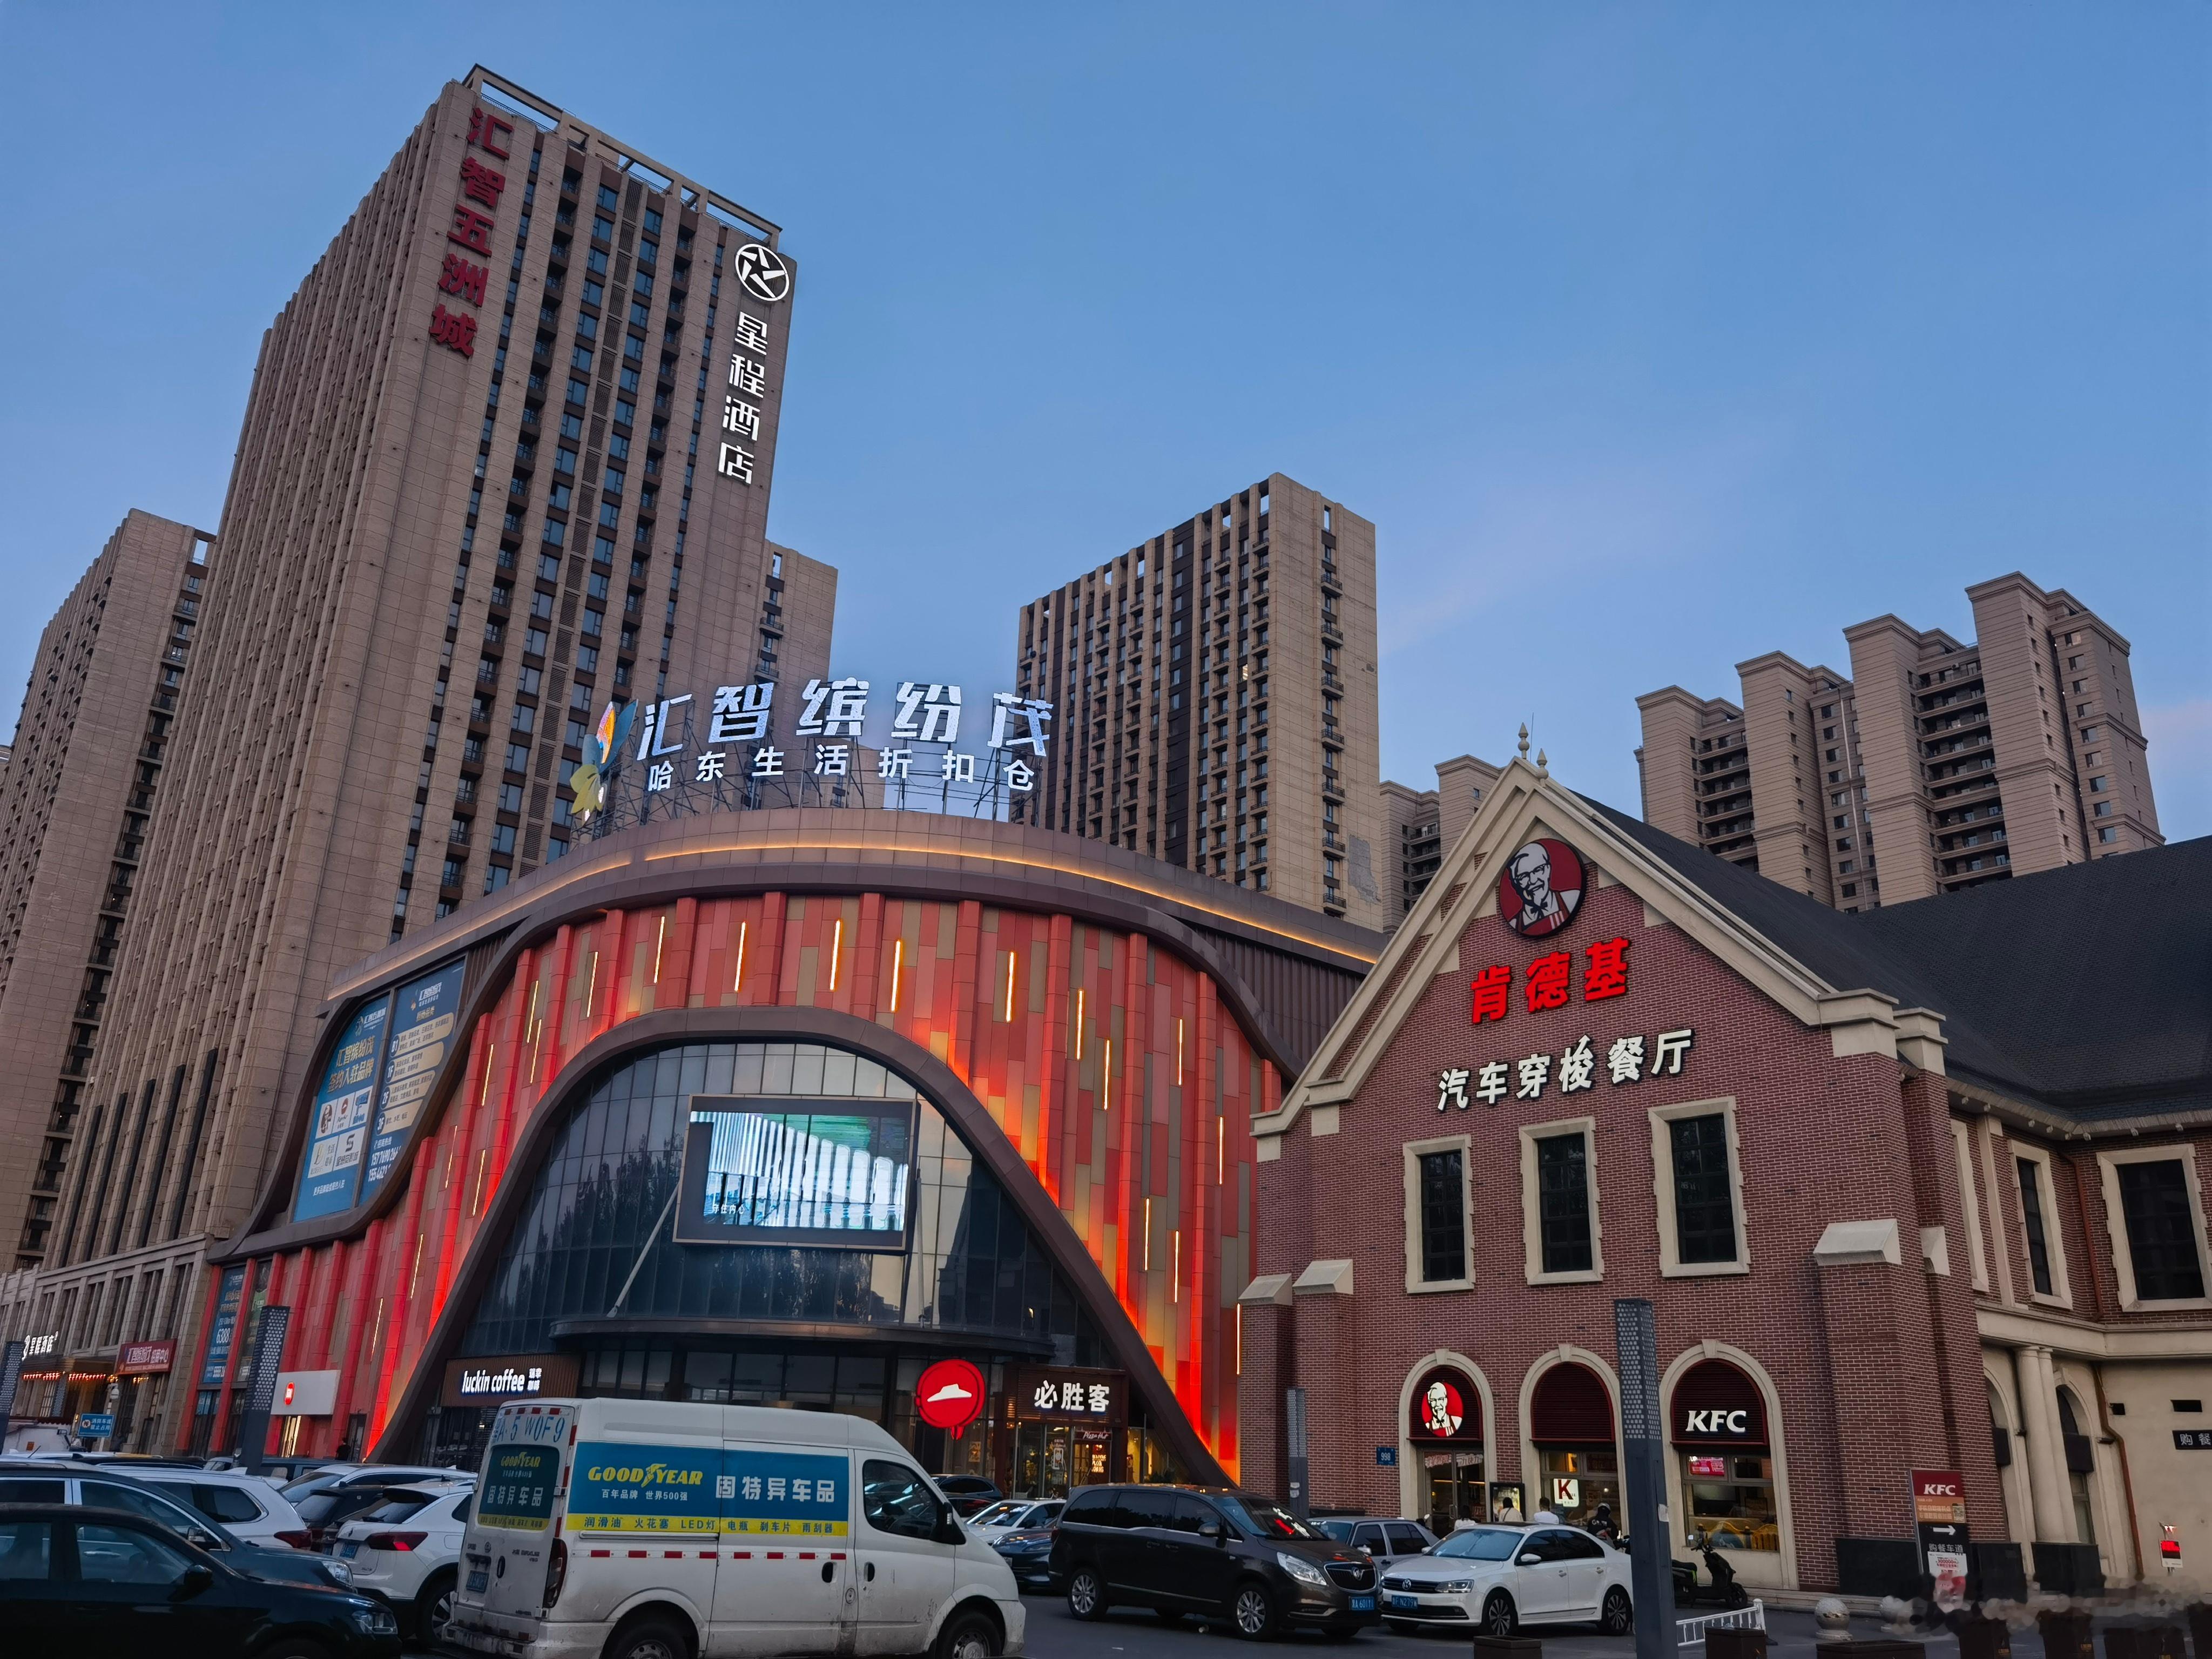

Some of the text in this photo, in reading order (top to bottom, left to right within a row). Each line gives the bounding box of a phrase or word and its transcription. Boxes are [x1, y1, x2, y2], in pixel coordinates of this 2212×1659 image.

[429, 107, 514, 357] 汇智五洲城
[718, 311, 768, 484] 星程酒店
[637, 677, 1054, 761] 汇智缤纷茂
[648, 744, 1035, 792] 哈东生活折扣仓
[1471, 937, 1630, 1024] 肯德基
[387, 1065, 394, 1078] 1F
[1437, 1029, 1692, 1111] 汽车穿梭餐厅
[381, 1091, 389, 1105] 2F
[712, 1204, 745, 1214] 守住内心
[216, 1327, 231, 1344] 6388
[462, 1368, 525, 1393] luckin coffee
[1034, 1380, 1110, 1412] 必胜客
[1685, 1410, 1747, 1433] KFC
[1082, 1431, 1097, 1439] Pizza
[2180, 1433, 2211, 1445] 购餐
[1381, 1452, 1391, 1461] 998
[588, 1464, 703, 1487] GOODYEAR
[487, 1485, 544, 1507] 固特异车品
[602, 1489, 688, 1501] 百年品牌 世界500强
[716, 1475, 835, 1503] 固特异车品
[1557, 1479, 1574, 1500] K
[1924, 1484, 1956, 1496] KFC
[584, 1516, 833, 1533] 润滑油 火花塞 LED灯 电瓶 刹车片 雨刮器
[1928, 1543, 1964, 1553] 购餐车道
